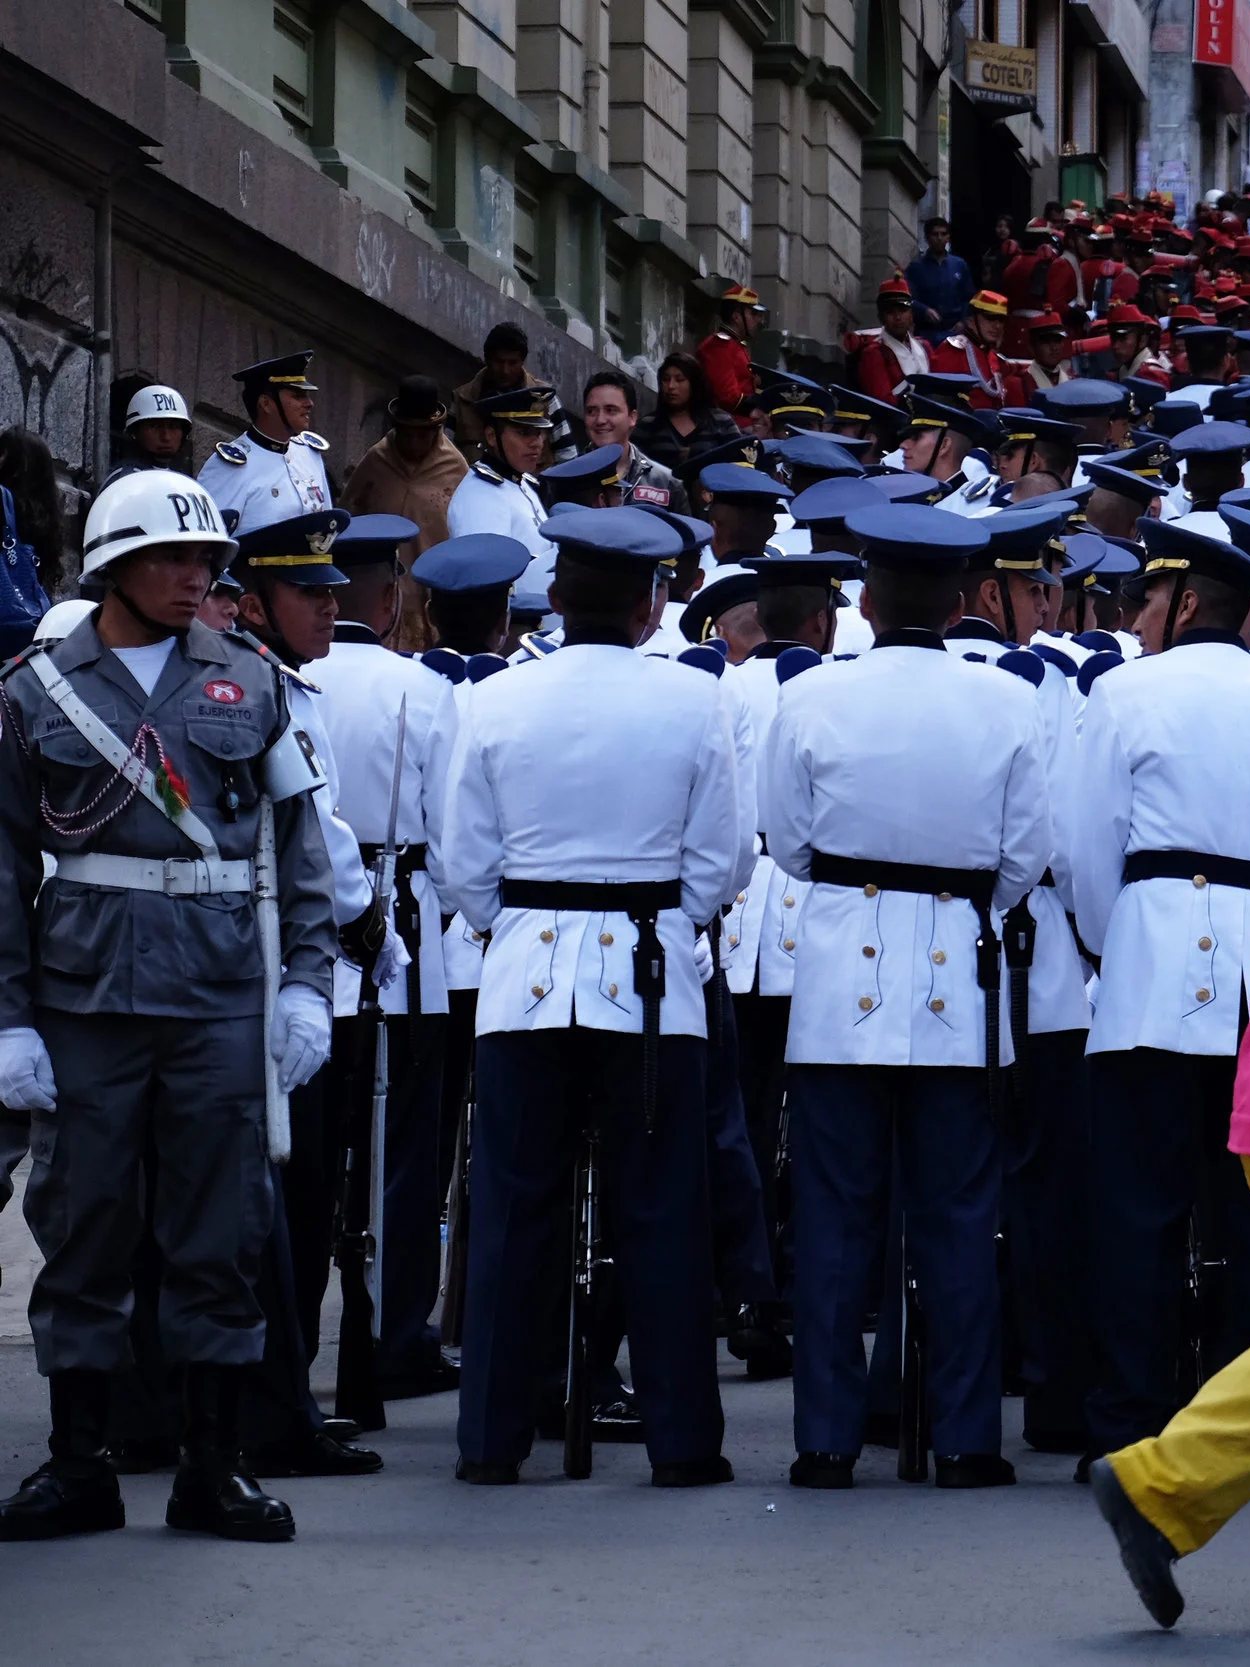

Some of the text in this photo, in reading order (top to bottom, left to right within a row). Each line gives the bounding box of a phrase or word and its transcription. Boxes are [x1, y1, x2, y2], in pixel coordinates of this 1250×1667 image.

[982, 62, 1023, 89] COTEL
[968, 88, 1022, 104] INTERNET
[153, 394, 177, 411] PM
[638, 488, 665, 502] TWA
[167, 492, 219, 533] PM
[197, 705, 252, 720] EJERCITO
[292, 729, 320, 779] P
